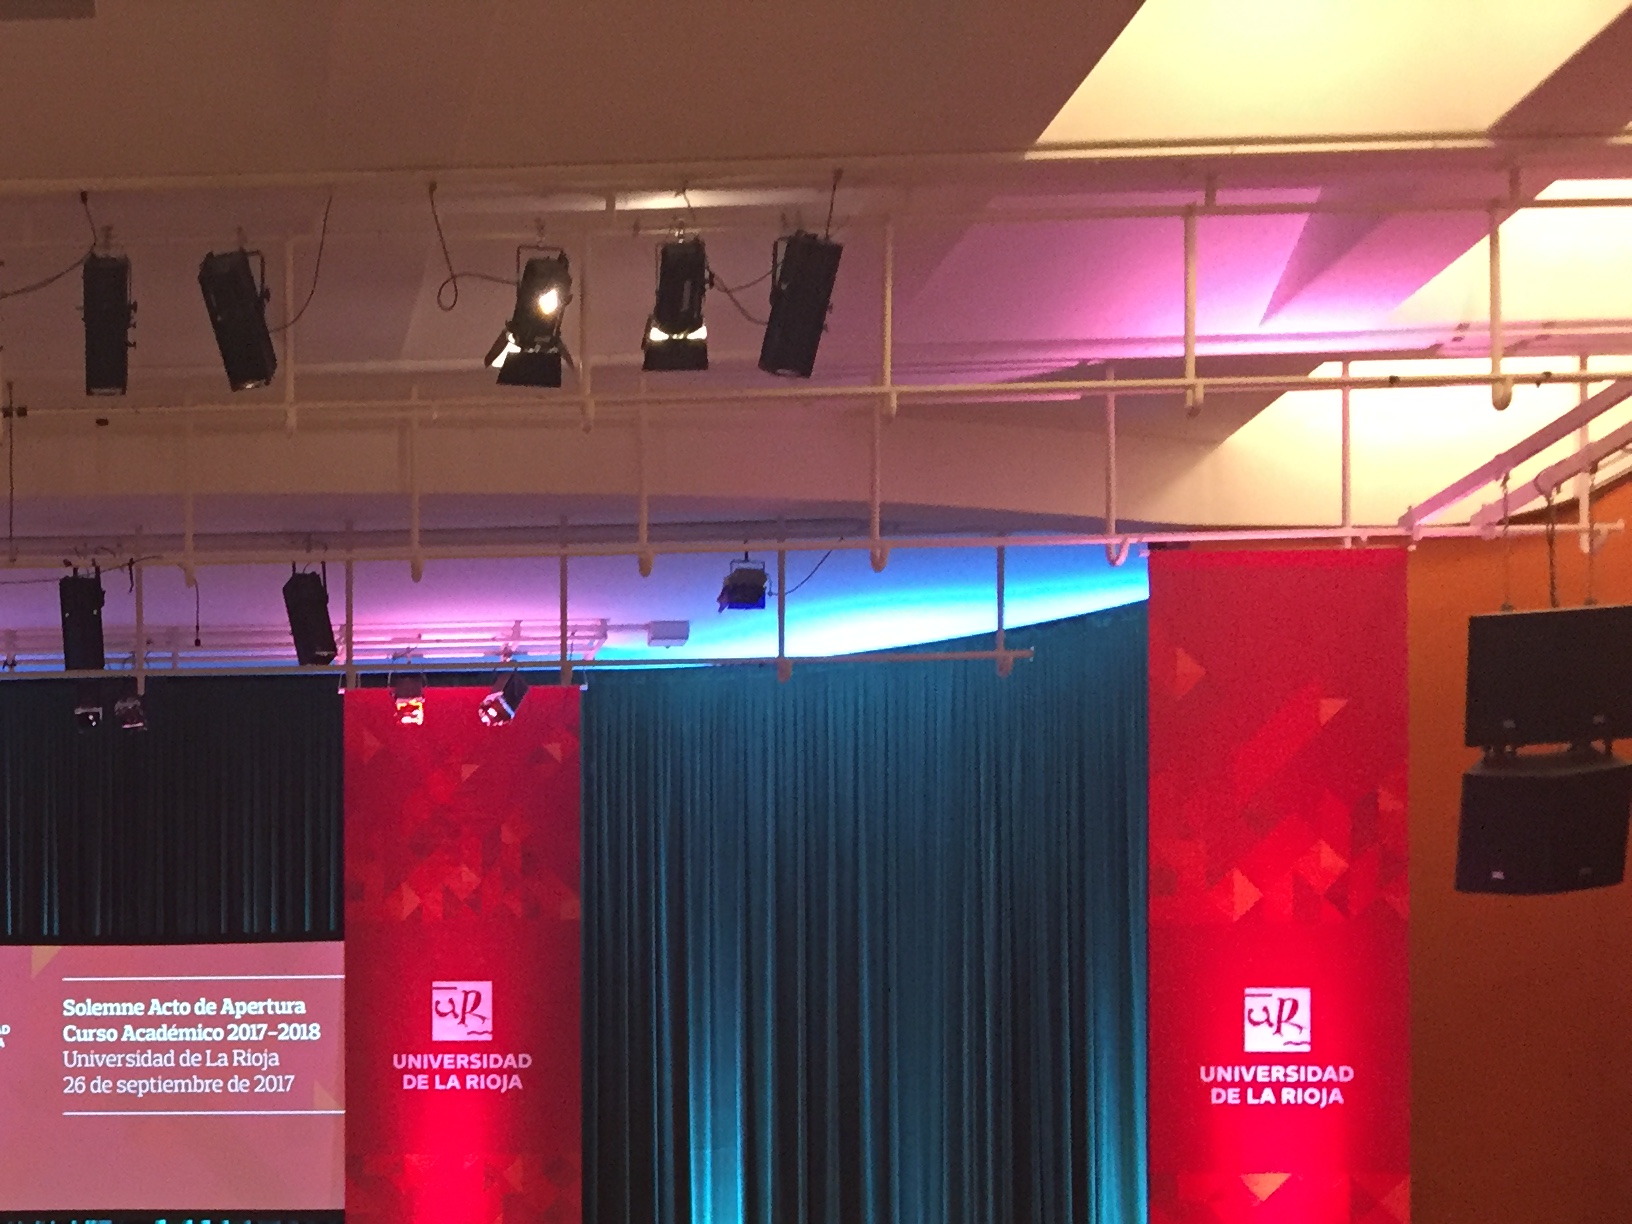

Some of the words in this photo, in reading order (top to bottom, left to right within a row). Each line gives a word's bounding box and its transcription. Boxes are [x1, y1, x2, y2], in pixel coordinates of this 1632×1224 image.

[62, 998, 146, 1016] Solemne
[147, 998, 191, 1016] Acto
[194, 997, 217, 1015] de
[219, 997, 307, 1019] Apertura
[62, 1025, 118, 1042] Curso
[120, 1023, 225, 1042] Académico
[62, 1049, 176, 1068] Universidad
[179, 1049, 202, 1067] de
[205, 1049, 229, 1067] La
[232, 1048, 280, 1071] Rioja
[392, 1053, 532, 1069] UNIVERSIDAD
[402, 1074, 429, 1090] DE
[434, 1074, 461, 1090] LA
[465, 1074, 523, 1093] RIOJA
[1200, 1065, 1354, 1082] UNIVERSIDAD
[62, 1076, 86, 1094] 26
[89, 1075, 113, 1094] de
[116, 1075, 224, 1098] septiembre
[227, 1075, 250, 1093] de
[253, 1075, 295, 1093] 2017
[1210, 1087, 1241, 1105] DE
[1246, 1087, 1276, 1105] LA
[1281, 1087, 1344, 1109] RIOJA
